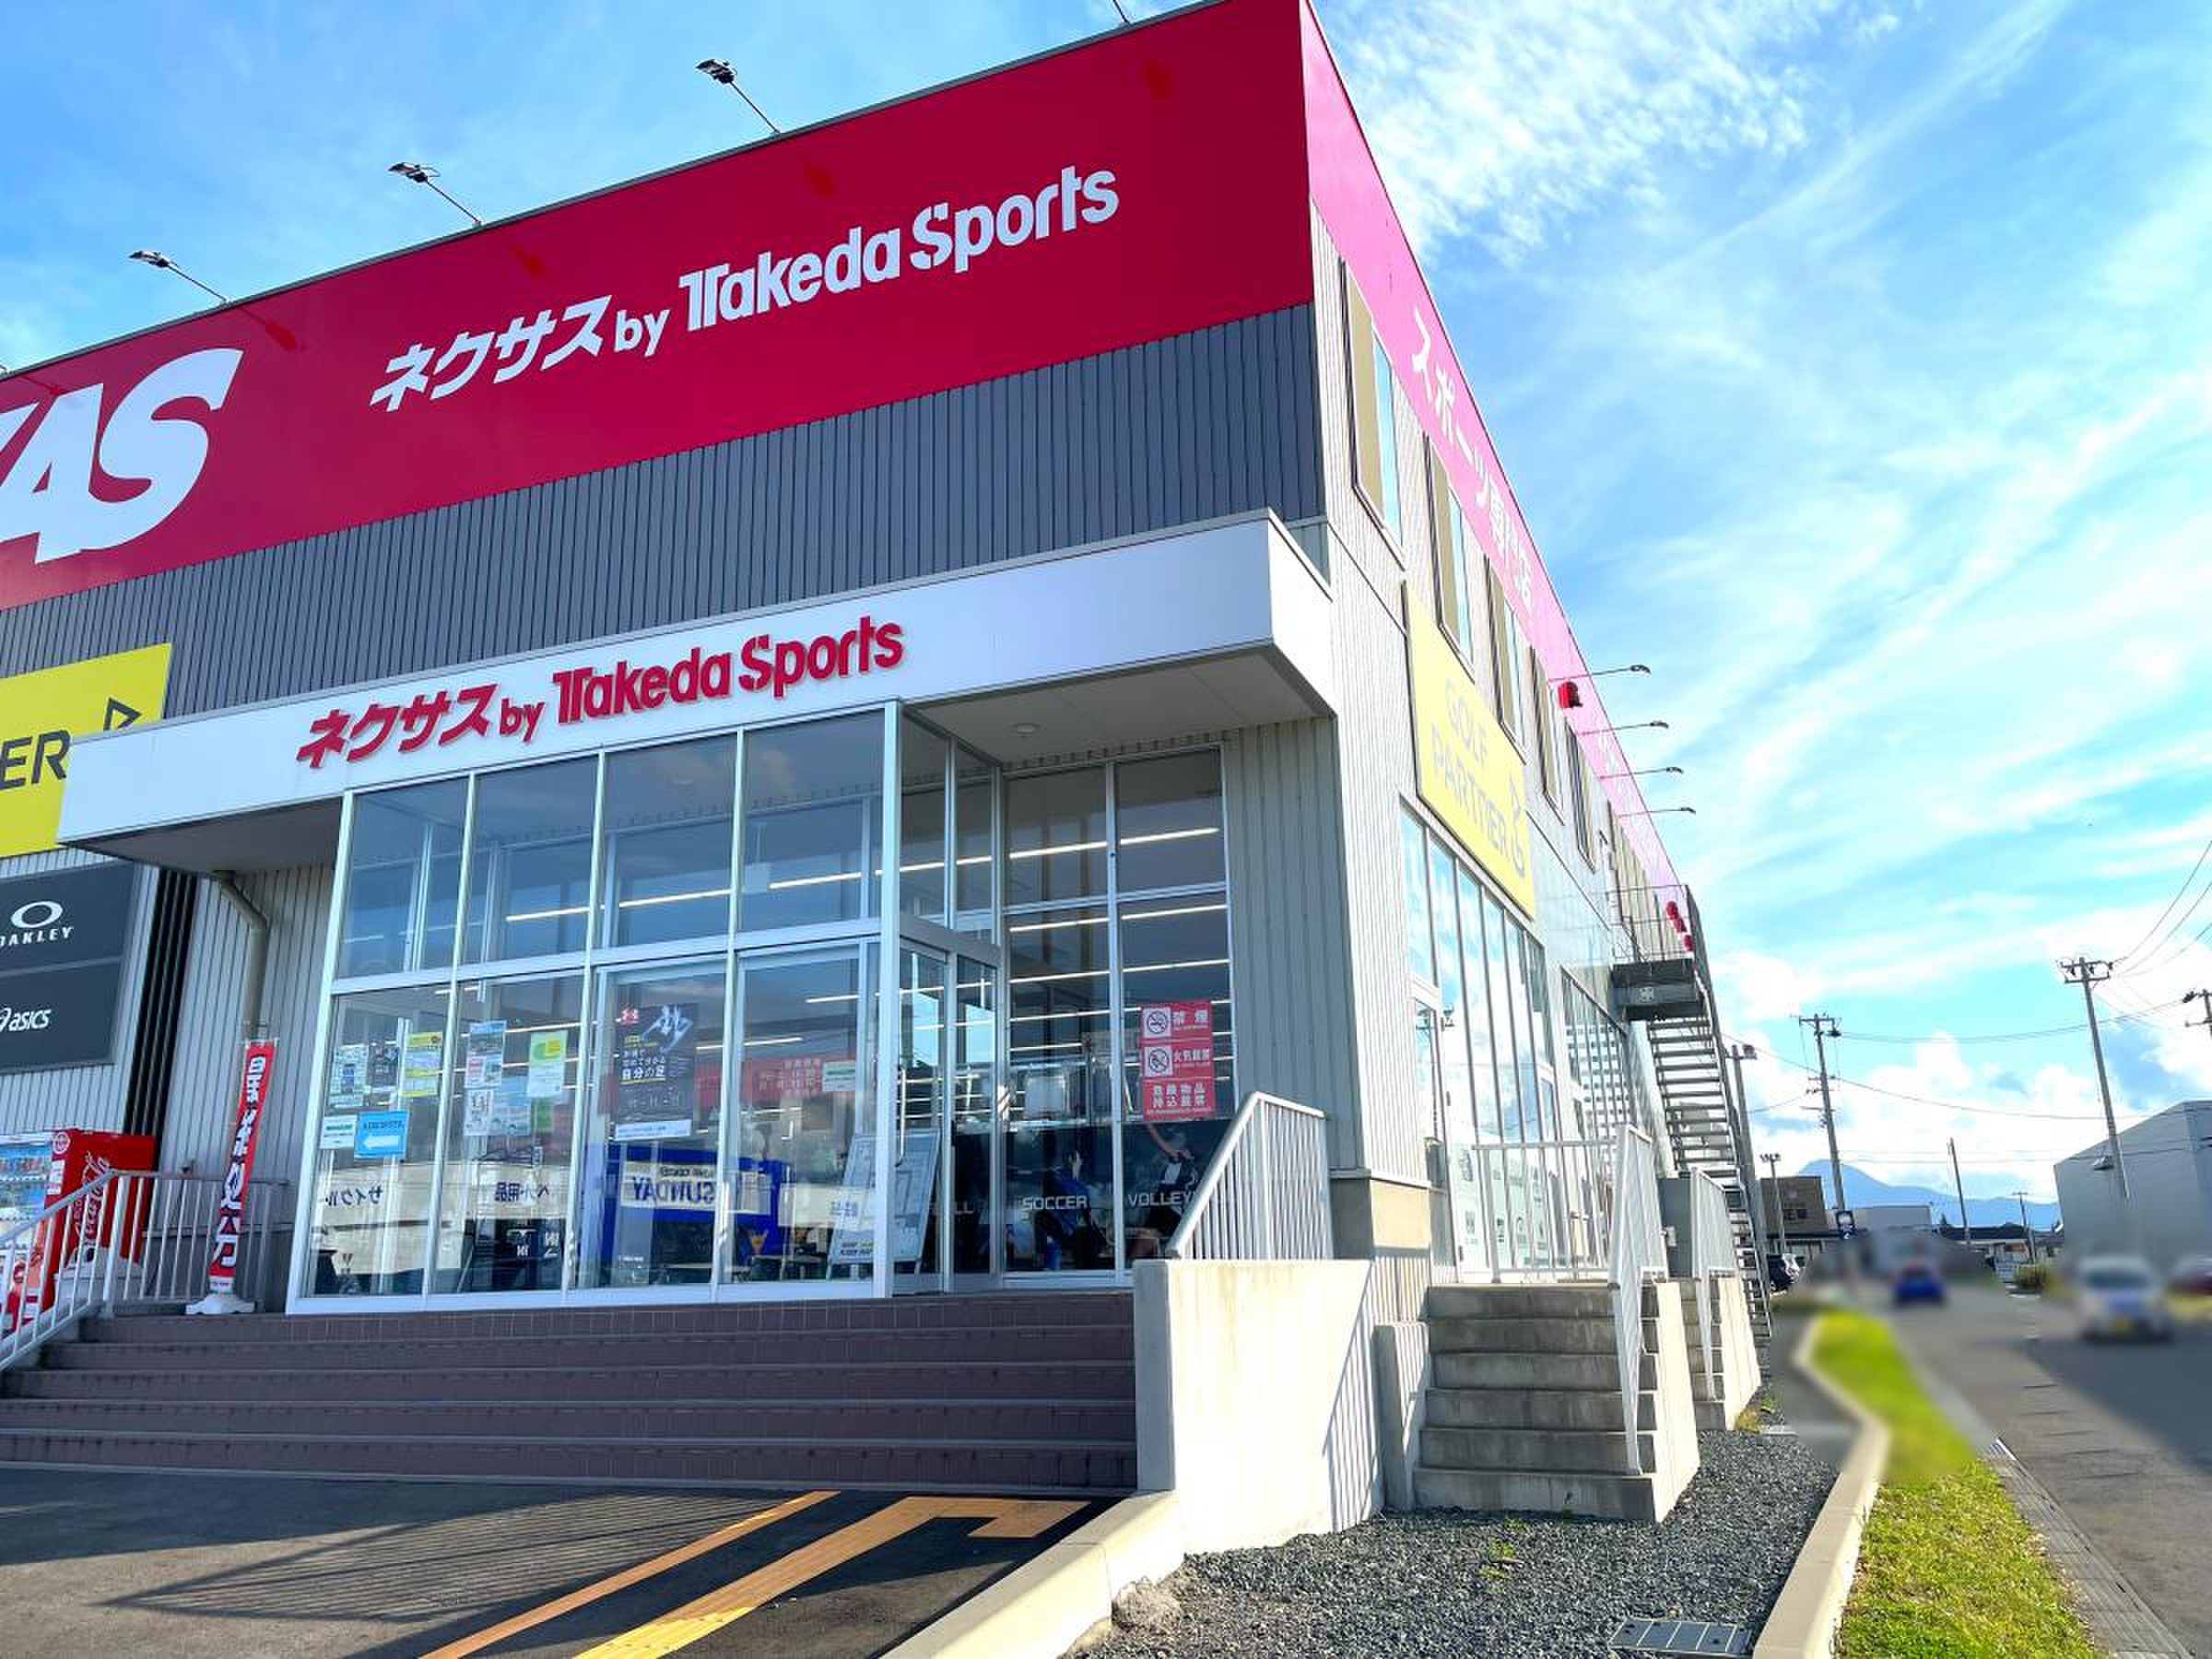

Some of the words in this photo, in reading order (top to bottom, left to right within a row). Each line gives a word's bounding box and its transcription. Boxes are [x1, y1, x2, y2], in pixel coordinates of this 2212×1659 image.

[370, 295, 612, 412] ネクサス
[614, 310, 670, 357] by
[678, 227, 900, 332] Takeda
[910, 165, 1120, 273] Sports
[296, 684, 498, 768] ネクサス
[500, 699, 545, 742] by
[553, 647, 732, 723] Takeda
[738, 616, 903, 698] Sports
[0, 730, 70, 790] ER
[1022, 1195, 1088, 1209] SOCCER
